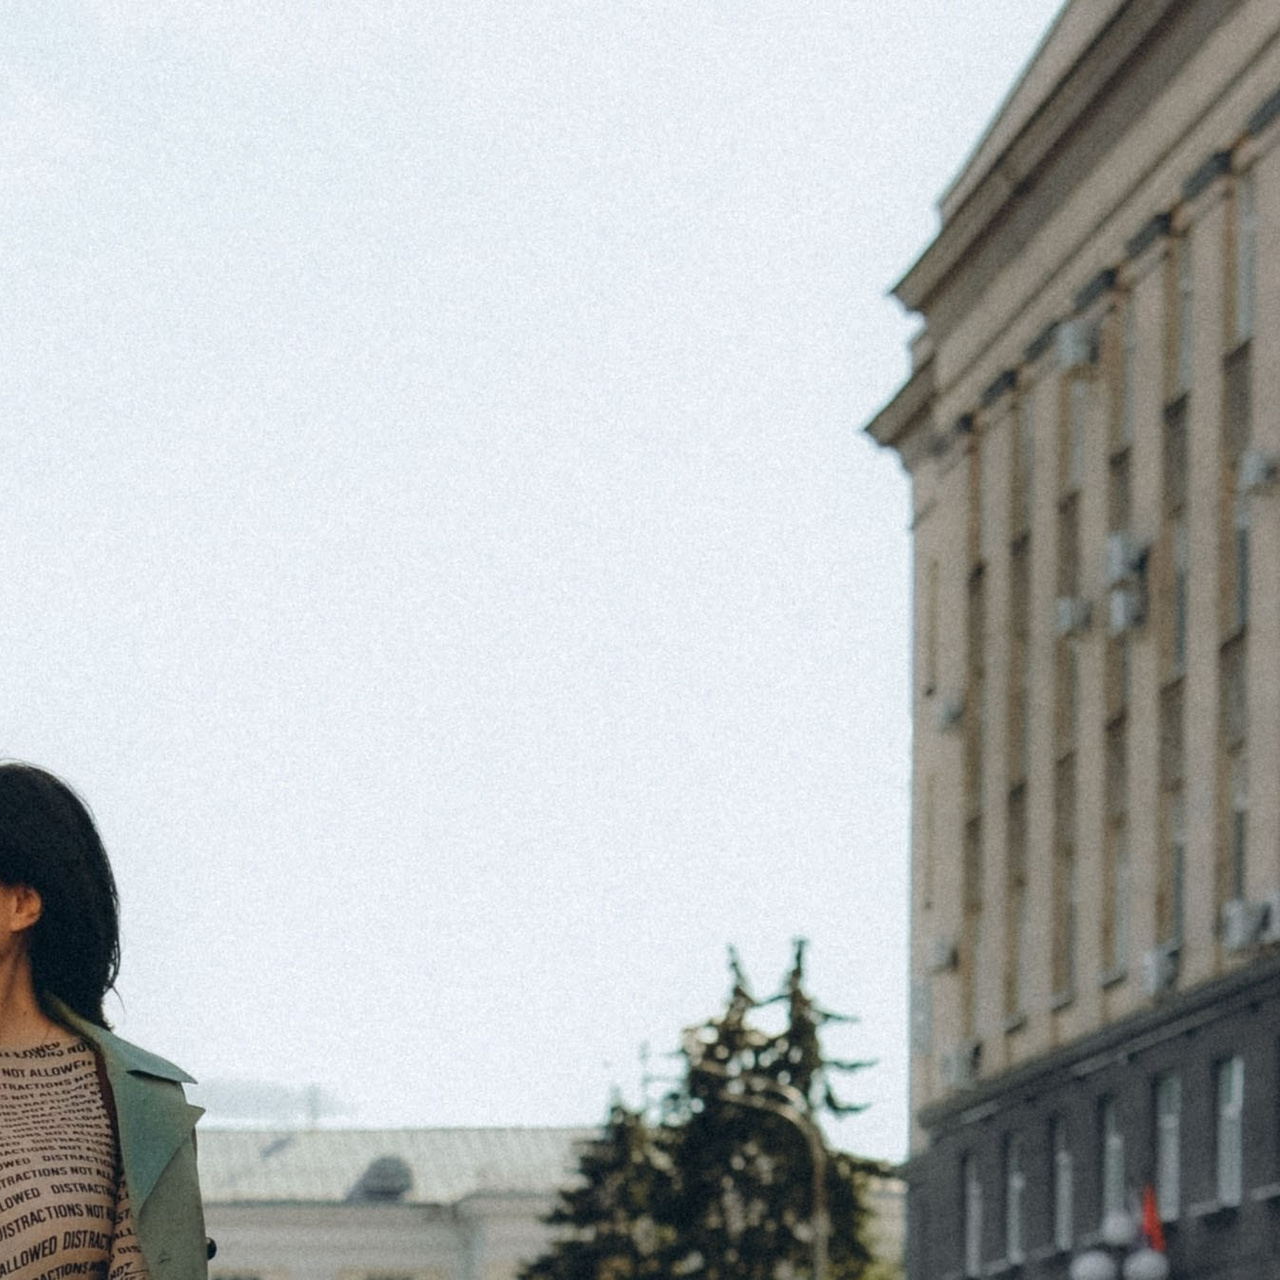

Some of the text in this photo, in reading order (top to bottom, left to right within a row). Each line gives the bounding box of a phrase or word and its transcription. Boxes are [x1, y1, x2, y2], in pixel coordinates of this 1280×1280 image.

[2, 1066, 26, 1079] NOT
[70, 1165, 93, 1177] NOT
[86, 1203, 106, 1219] NOT
[0, 1234, 59, 1280] ALLOWED
